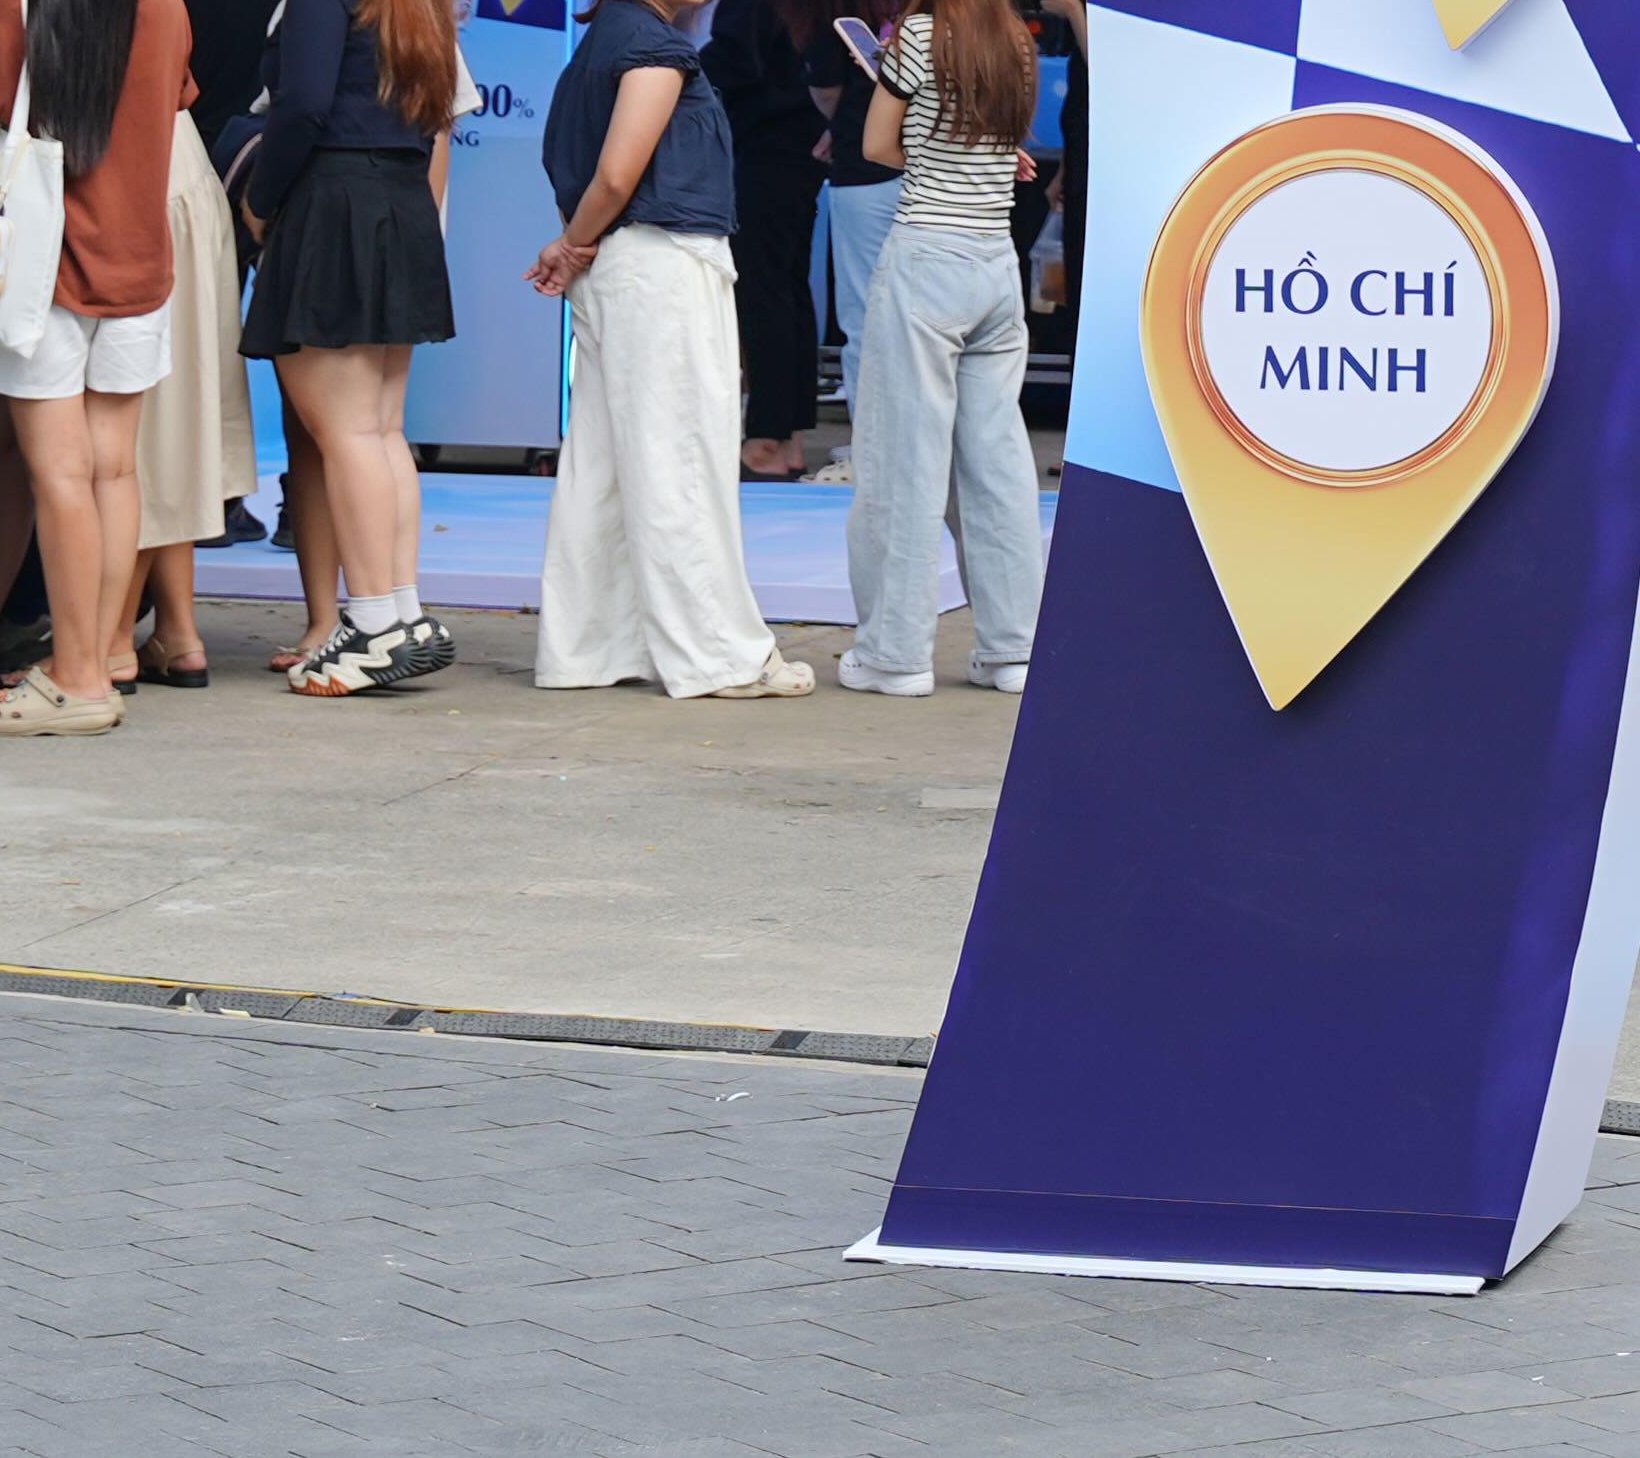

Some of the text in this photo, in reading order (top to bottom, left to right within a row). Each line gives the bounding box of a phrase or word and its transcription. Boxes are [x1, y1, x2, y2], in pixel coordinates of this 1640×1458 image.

[471, 83, 535, 119] 00%
[1233, 250, 1459, 318] HỒ CHÍ
[1259, 343, 1427, 394] MINH
